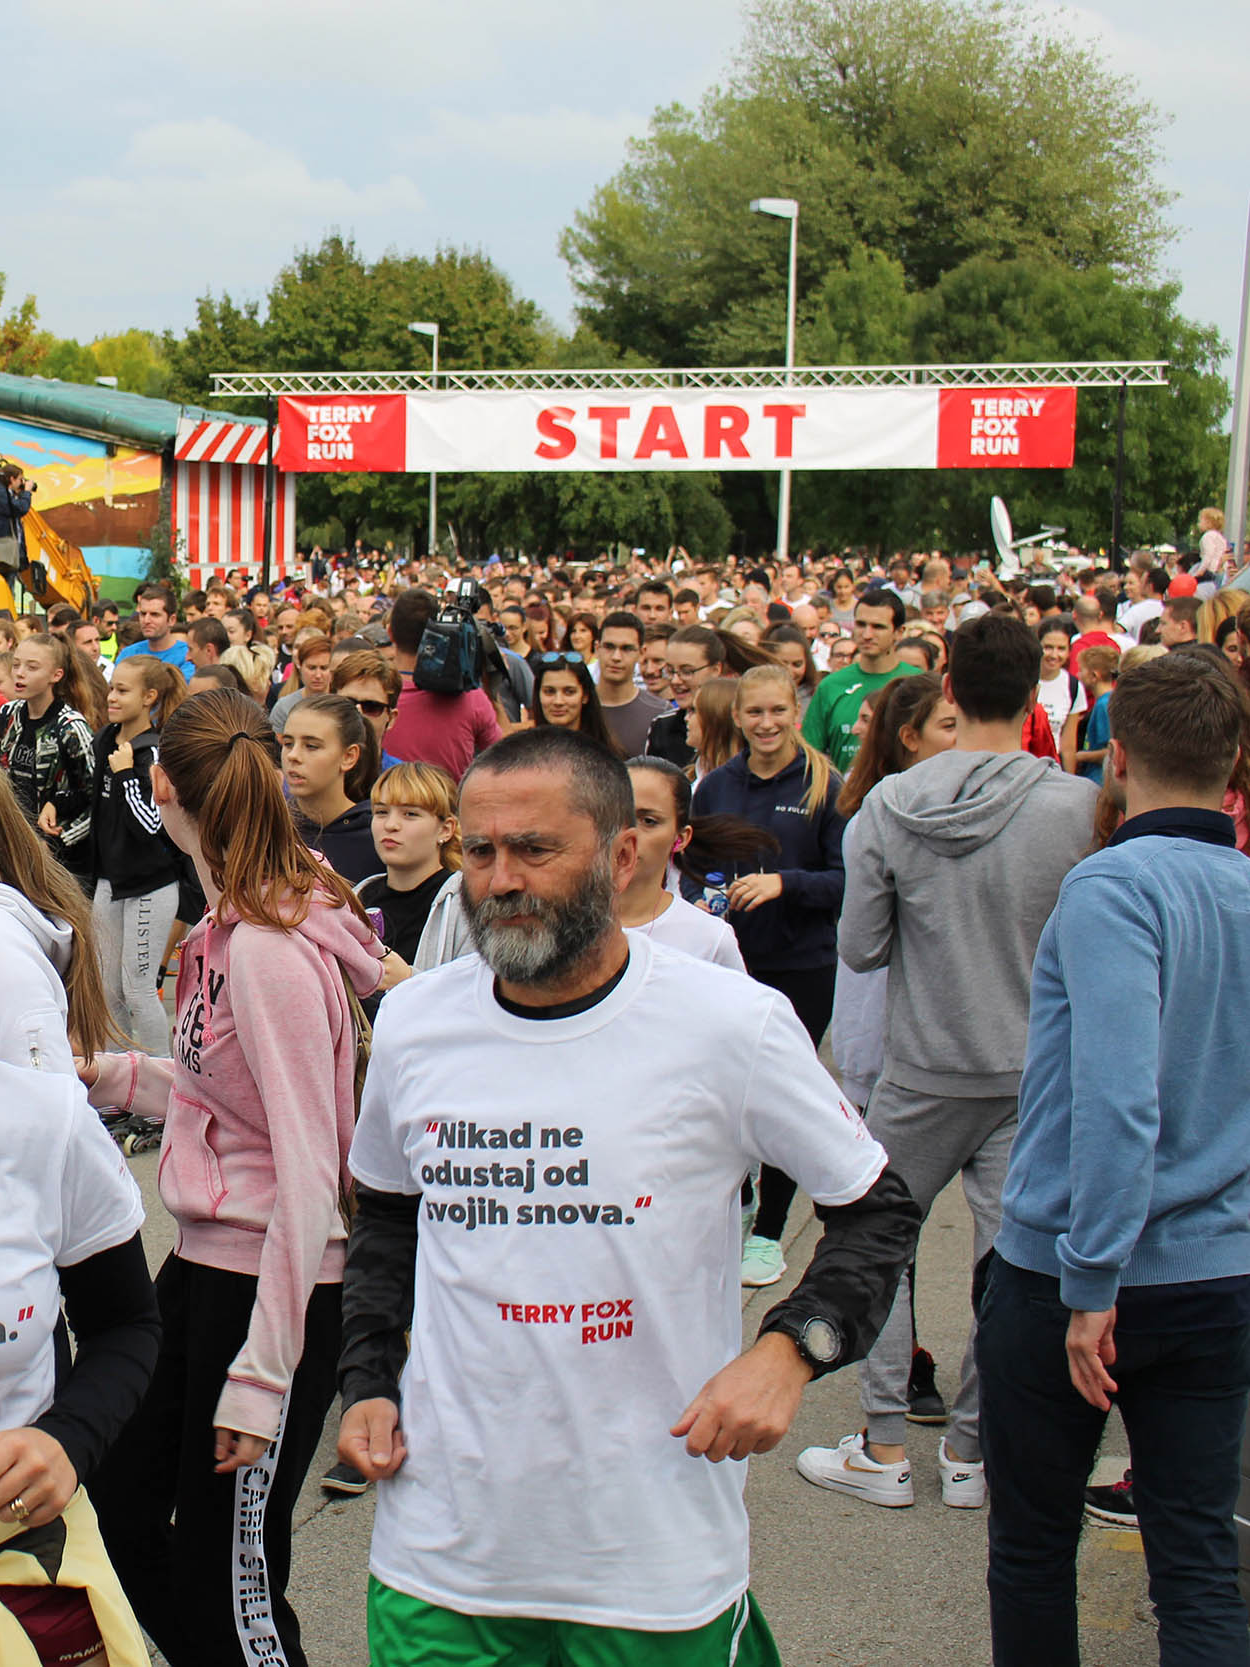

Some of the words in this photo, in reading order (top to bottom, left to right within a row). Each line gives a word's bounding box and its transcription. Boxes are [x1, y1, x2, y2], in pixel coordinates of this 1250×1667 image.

[307, 405, 376, 423] TERRY
[971, 398, 1045, 417] TERRY
[307, 424, 352, 442] FOX
[534, 404, 806, 460] START
[971, 418, 1018, 436] FOX
[307, 443, 354, 460] RUN
[970, 437, 1020, 455] RUN
[540, 1126, 583, 1148] ne
[421, 1158, 535, 1193] odustaj
[543, 1159, 589, 1187] od
[497, 1302, 575, 1323] TERRY
[582, 1299, 634, 1322] FOX
[582, 1320, 633, 1345] RUN
[238, 1467, 270, 1545] CARE
[239, 1553, 268, 1630] STILL
